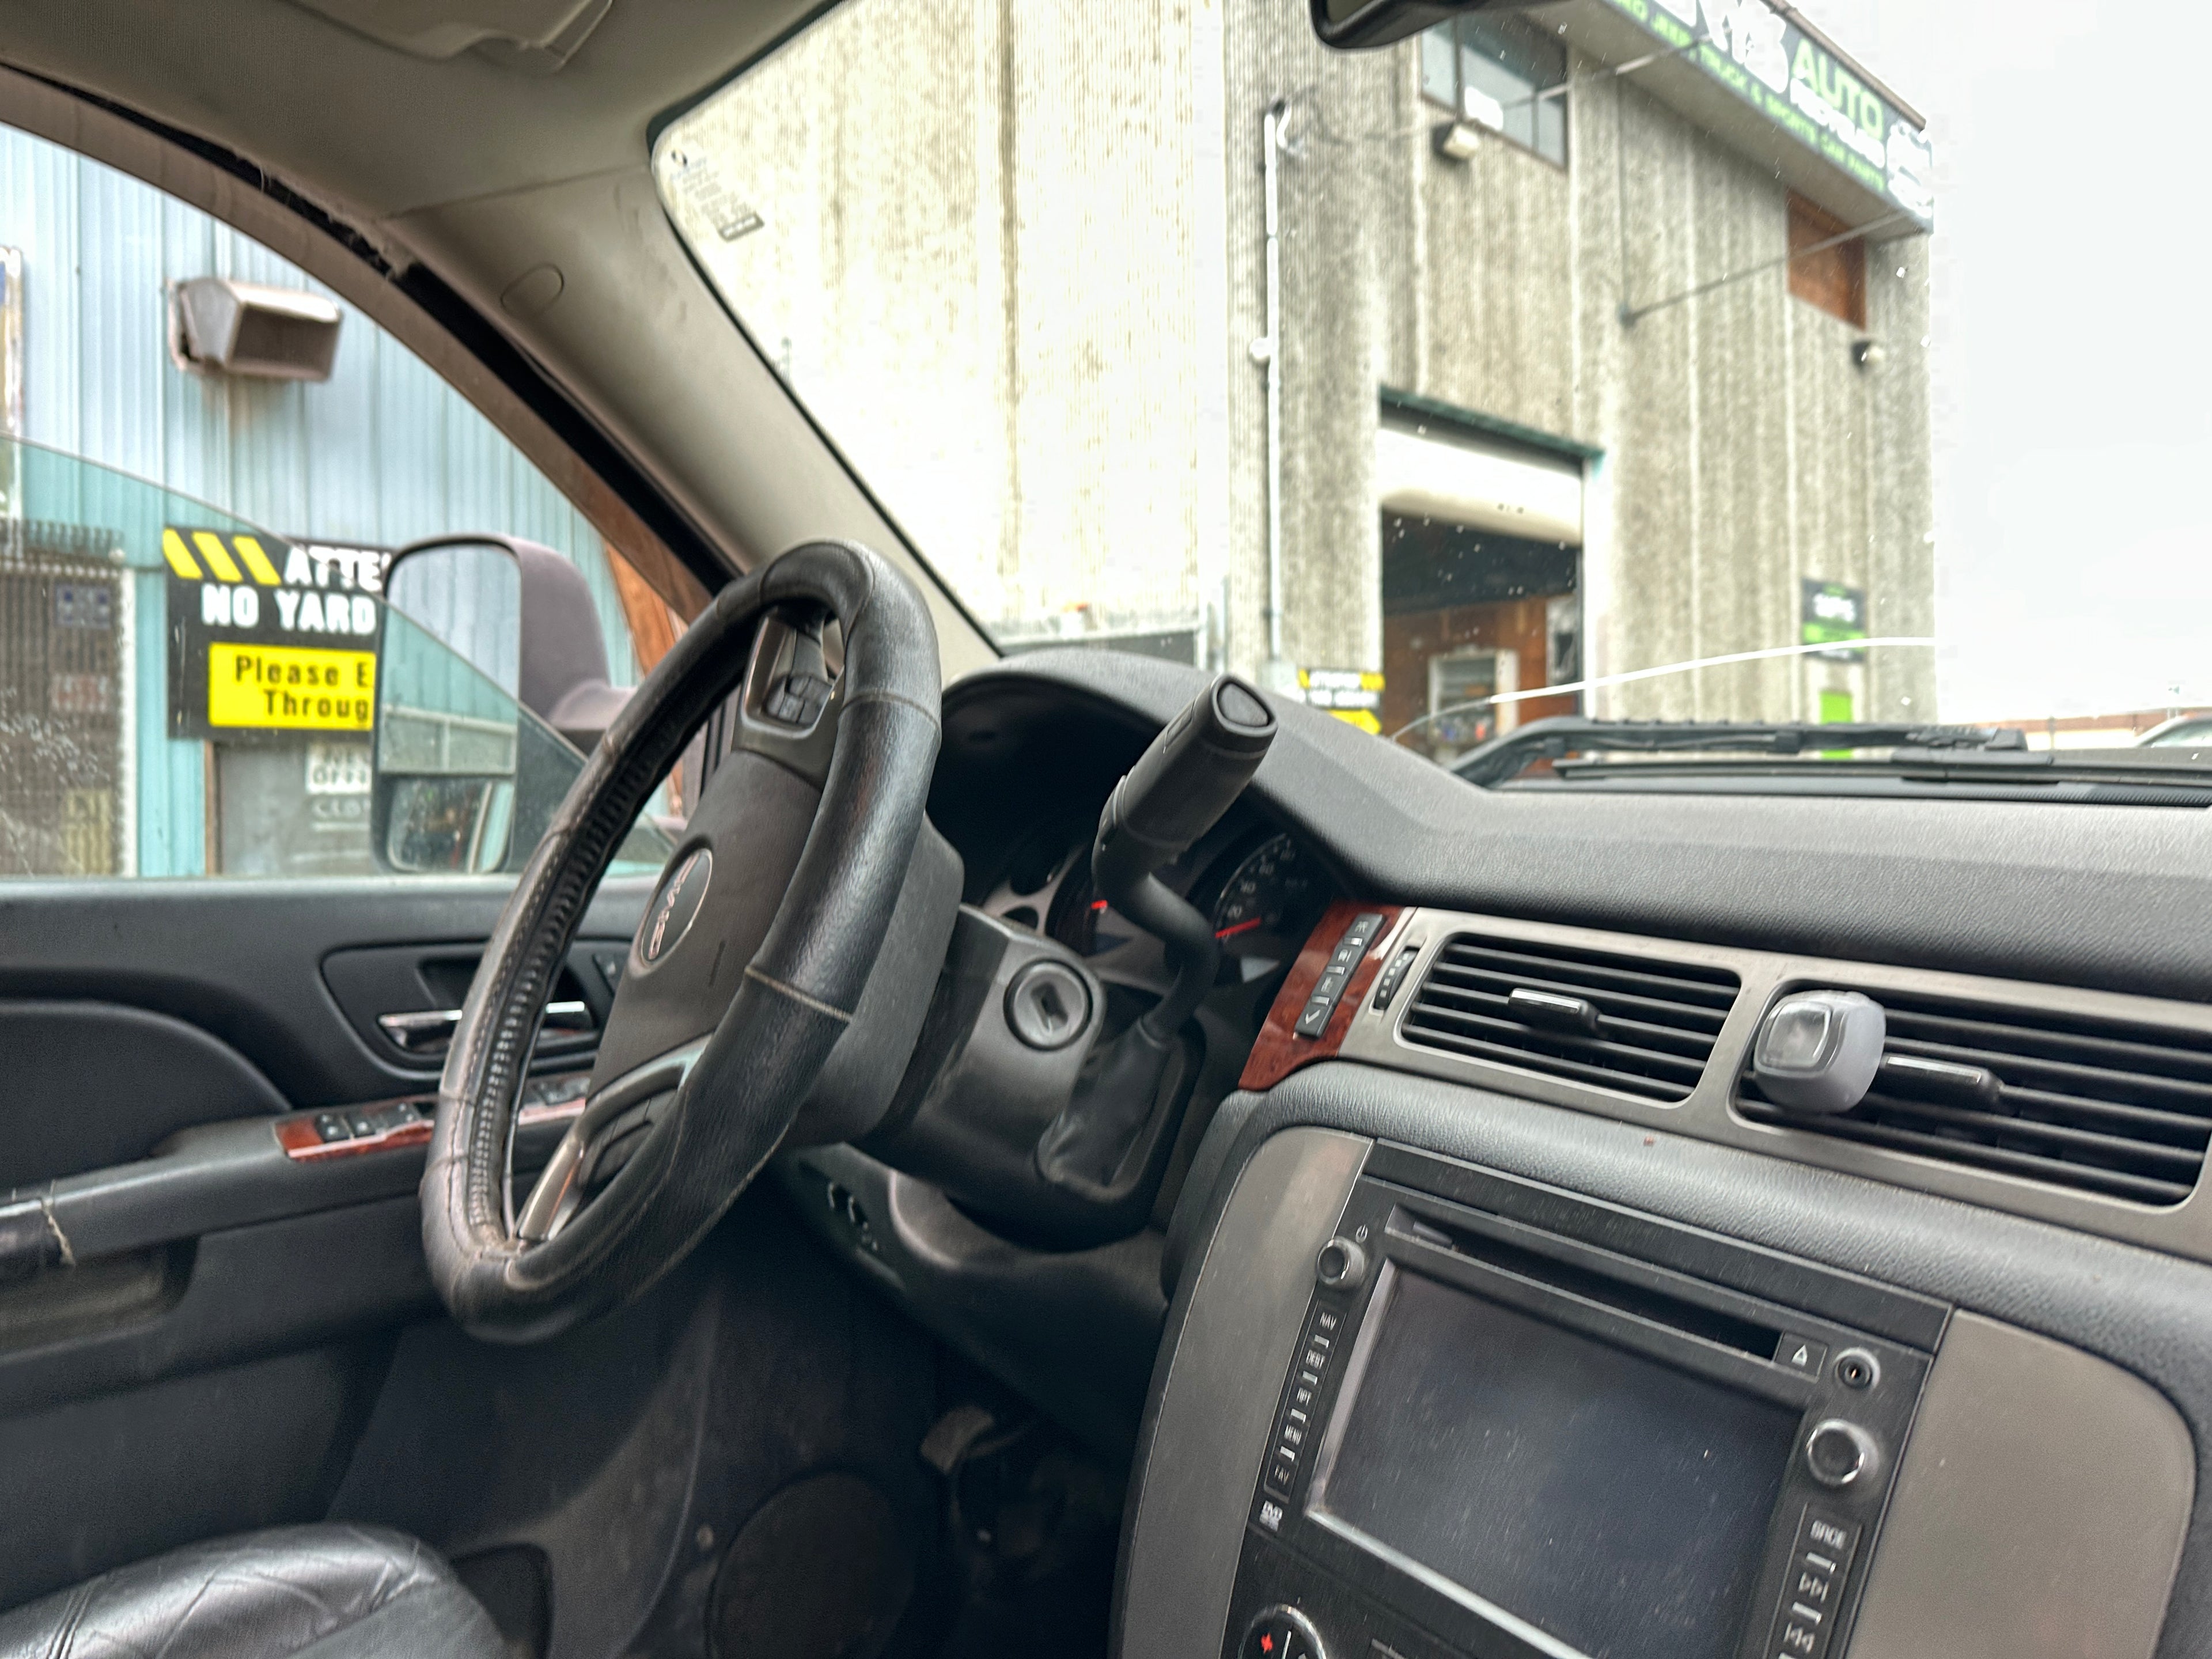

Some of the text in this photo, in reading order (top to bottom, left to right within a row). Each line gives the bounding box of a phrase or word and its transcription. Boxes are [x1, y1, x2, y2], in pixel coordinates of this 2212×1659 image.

[1791, 37, 1883, 141] AUTO
[284, 544, 392, 591] ATTE
[200, 582, 377, 635] NO YARD
[236, 654, 339, 687] Please
[263, 688, 369, 724] Throug
[1319, 1312, 1337, 1331] NAV
[1274, 1464, 1290, 1486] FAV
